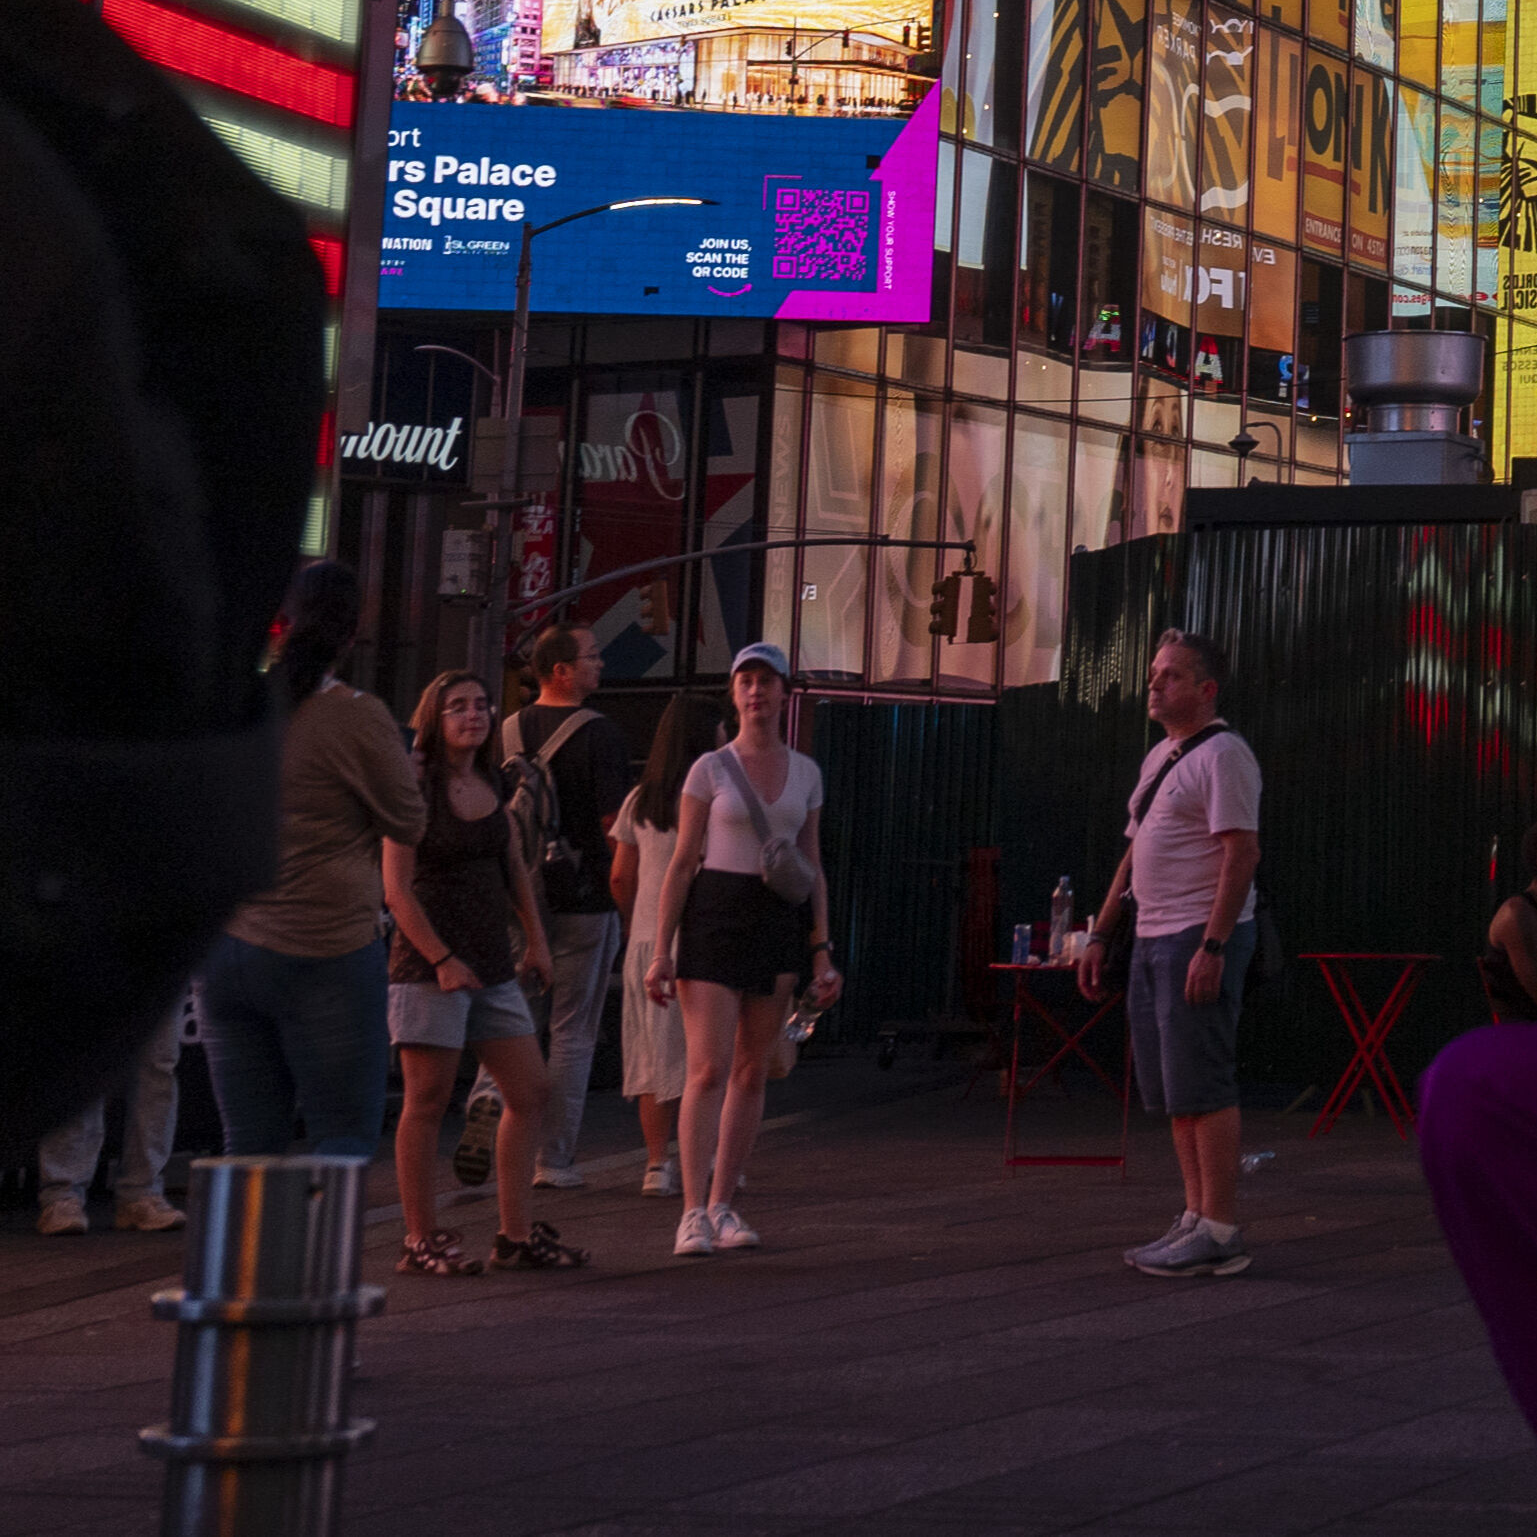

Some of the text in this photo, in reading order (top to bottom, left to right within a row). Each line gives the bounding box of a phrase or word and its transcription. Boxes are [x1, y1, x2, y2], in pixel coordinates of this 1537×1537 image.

[650, 0, 704, 22] CAESARS
[388, 128, 422, 147] ort
[434, 155, 557, 187] Palace
[393, 189, 525, 226] Square
[382, 237, 433, 251] NATION
[699, 239, 752, 251] JOIN US,
[884, 191, 896, 290] SHOW YOUR SUPPORT
[1305, 217, 1385, 256] ENTRANCE ON 45TH
[686, 252, 749, 264] SCAN THE
[692, 266, 749, 278] QR CODE
